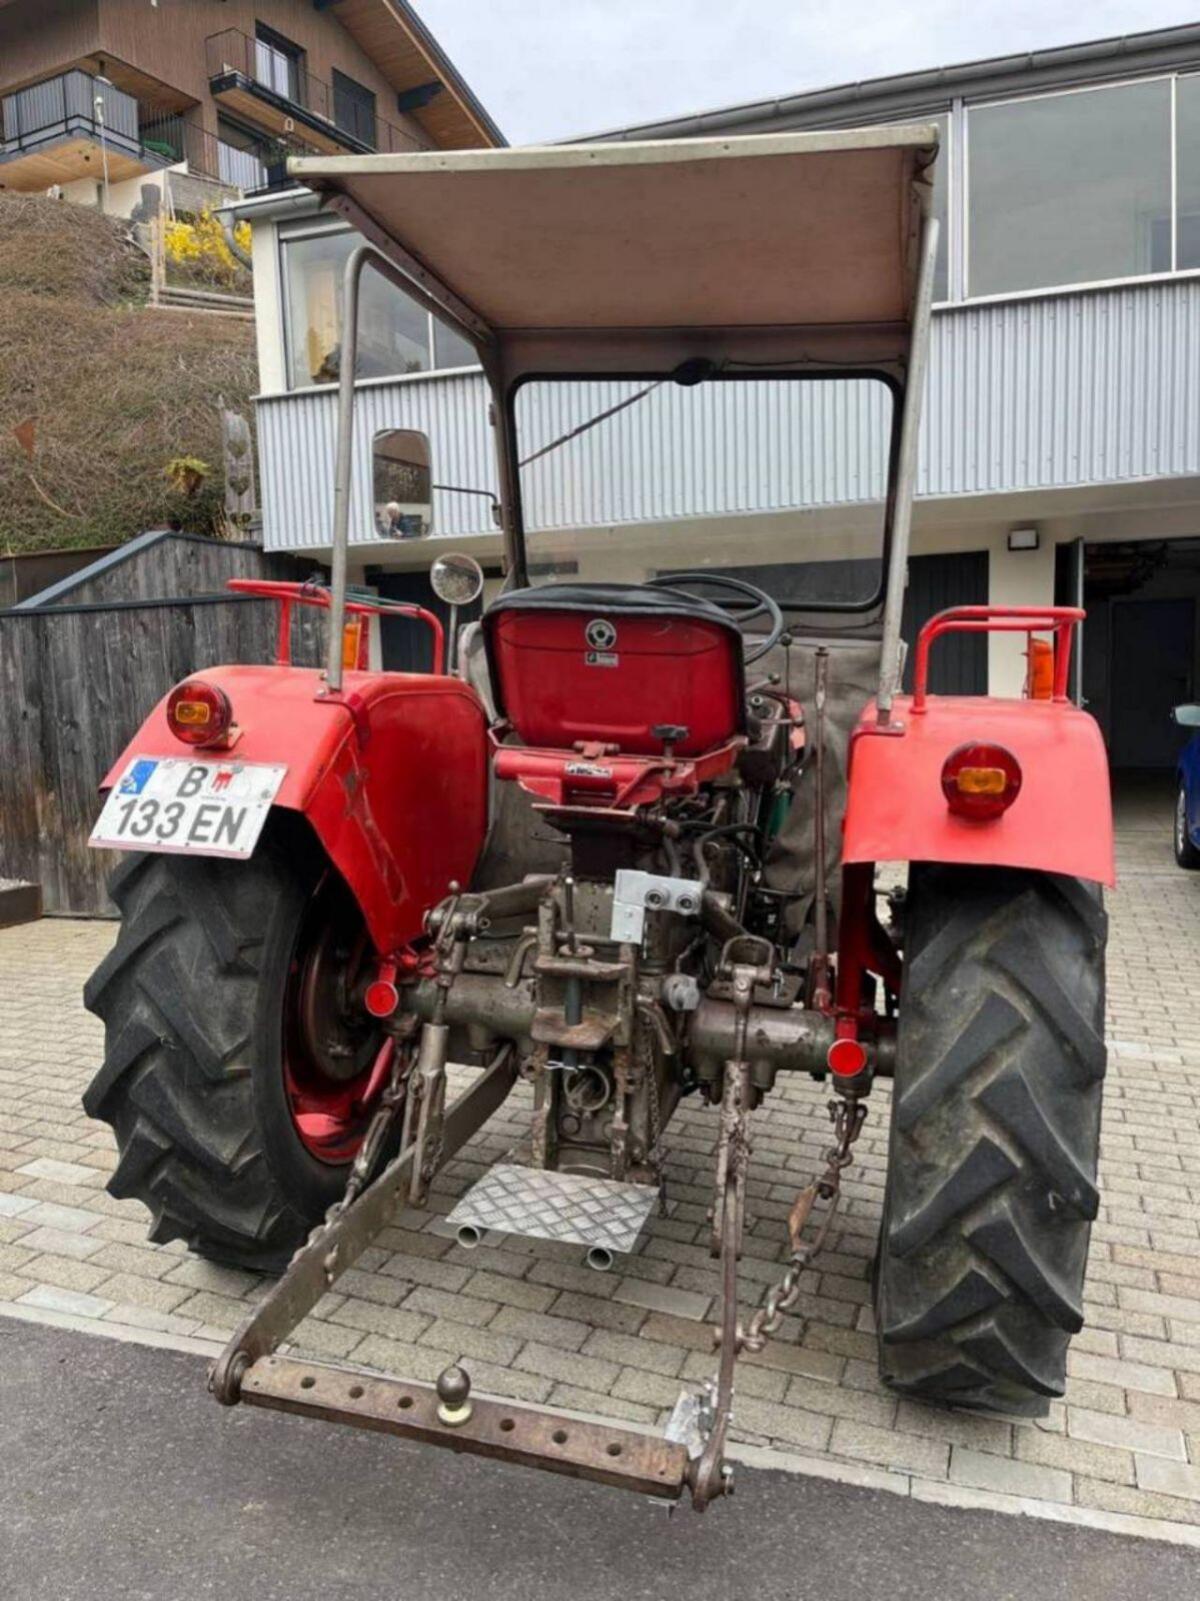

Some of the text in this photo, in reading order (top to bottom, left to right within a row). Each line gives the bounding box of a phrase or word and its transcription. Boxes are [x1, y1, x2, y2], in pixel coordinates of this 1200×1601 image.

[176, 766, 209, 798] B
[117, 799, 248, 845] 133 EN
